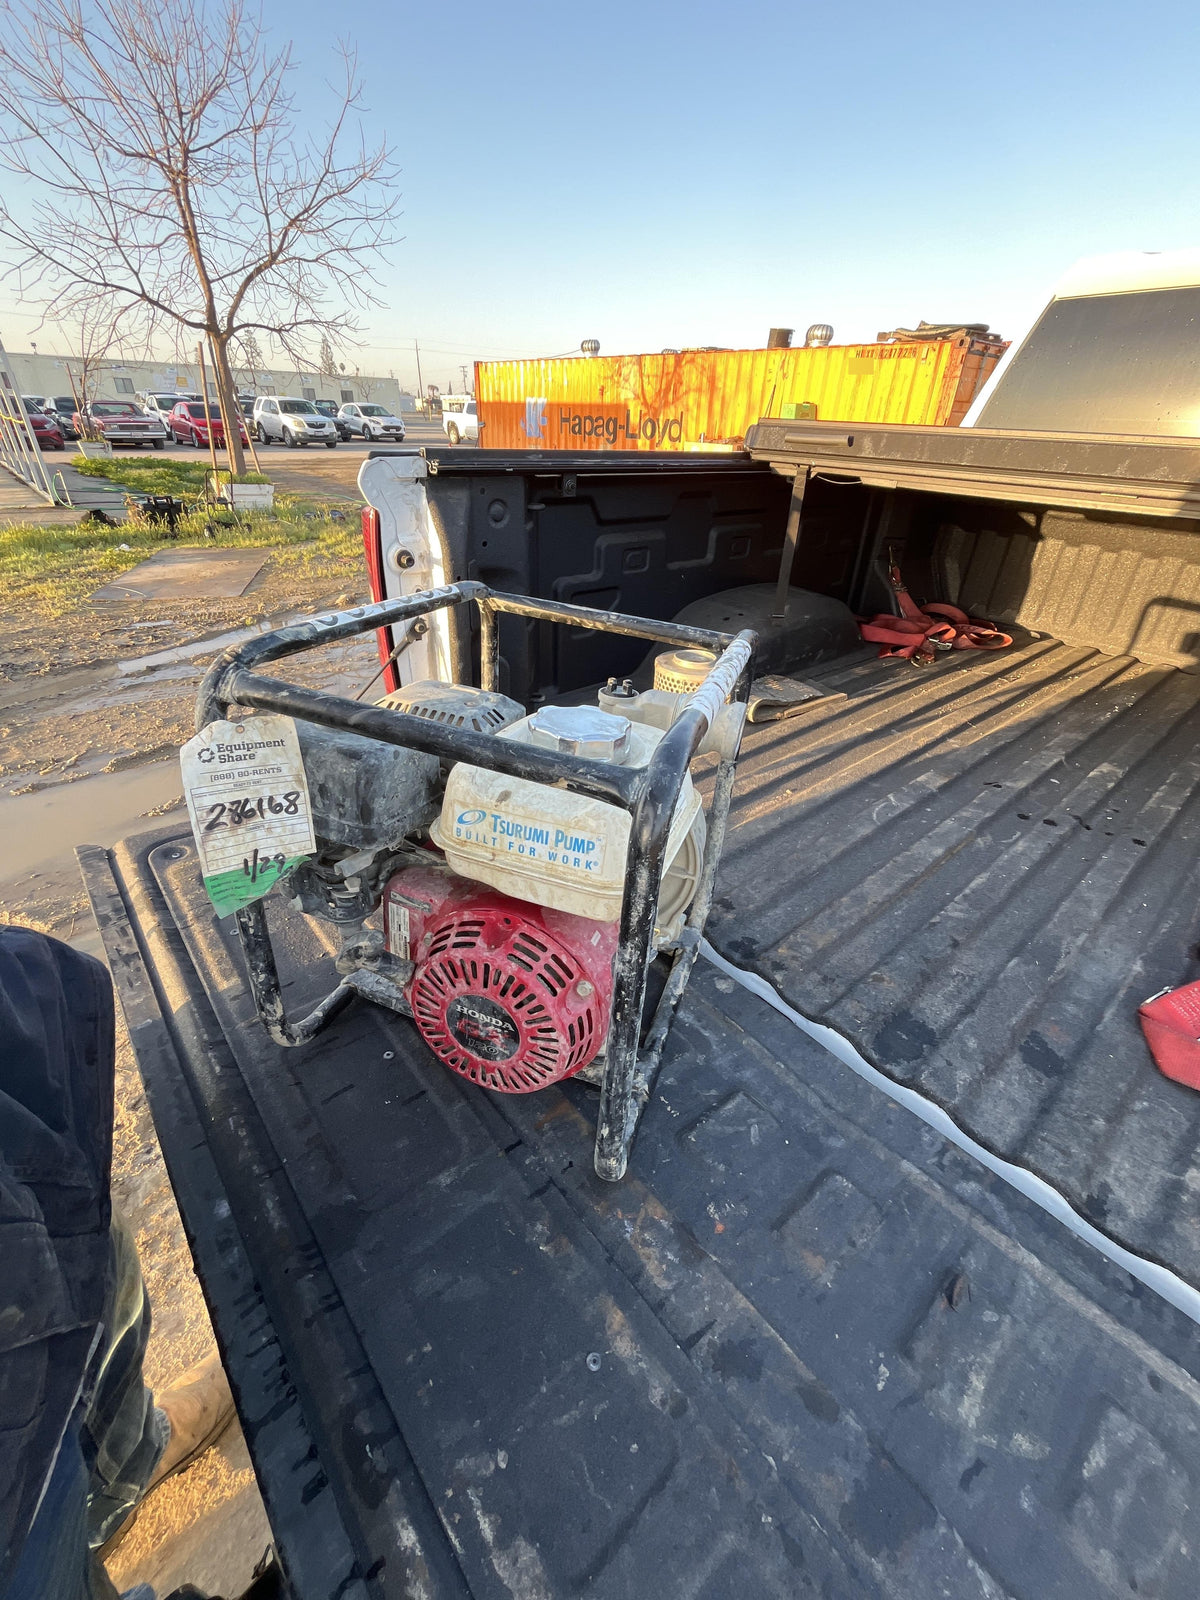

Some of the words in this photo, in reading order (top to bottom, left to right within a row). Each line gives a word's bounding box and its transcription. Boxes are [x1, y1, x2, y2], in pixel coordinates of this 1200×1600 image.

[559, 407, 684, 447] Hapag-Lloyd
[216, 738, 286, 754] Equipment
[218, 753, 256, 764] Share
[210, 772, 235, 782] (888)
[237, 766, 282, 778] 80-RENTS
[204, 791, 300, 830] 286168
[456, 827, 498, 847] BUILT
[508, 841, 536, 857] FOR
[548, 851, 593, 871] WORK
[490, 813, 550, 846] TSURUMI
[554, 829, 596, 855] PUMP
[243, 848, 286, 883] 1/29
[455, 1004, 515, 1033] HONDA
